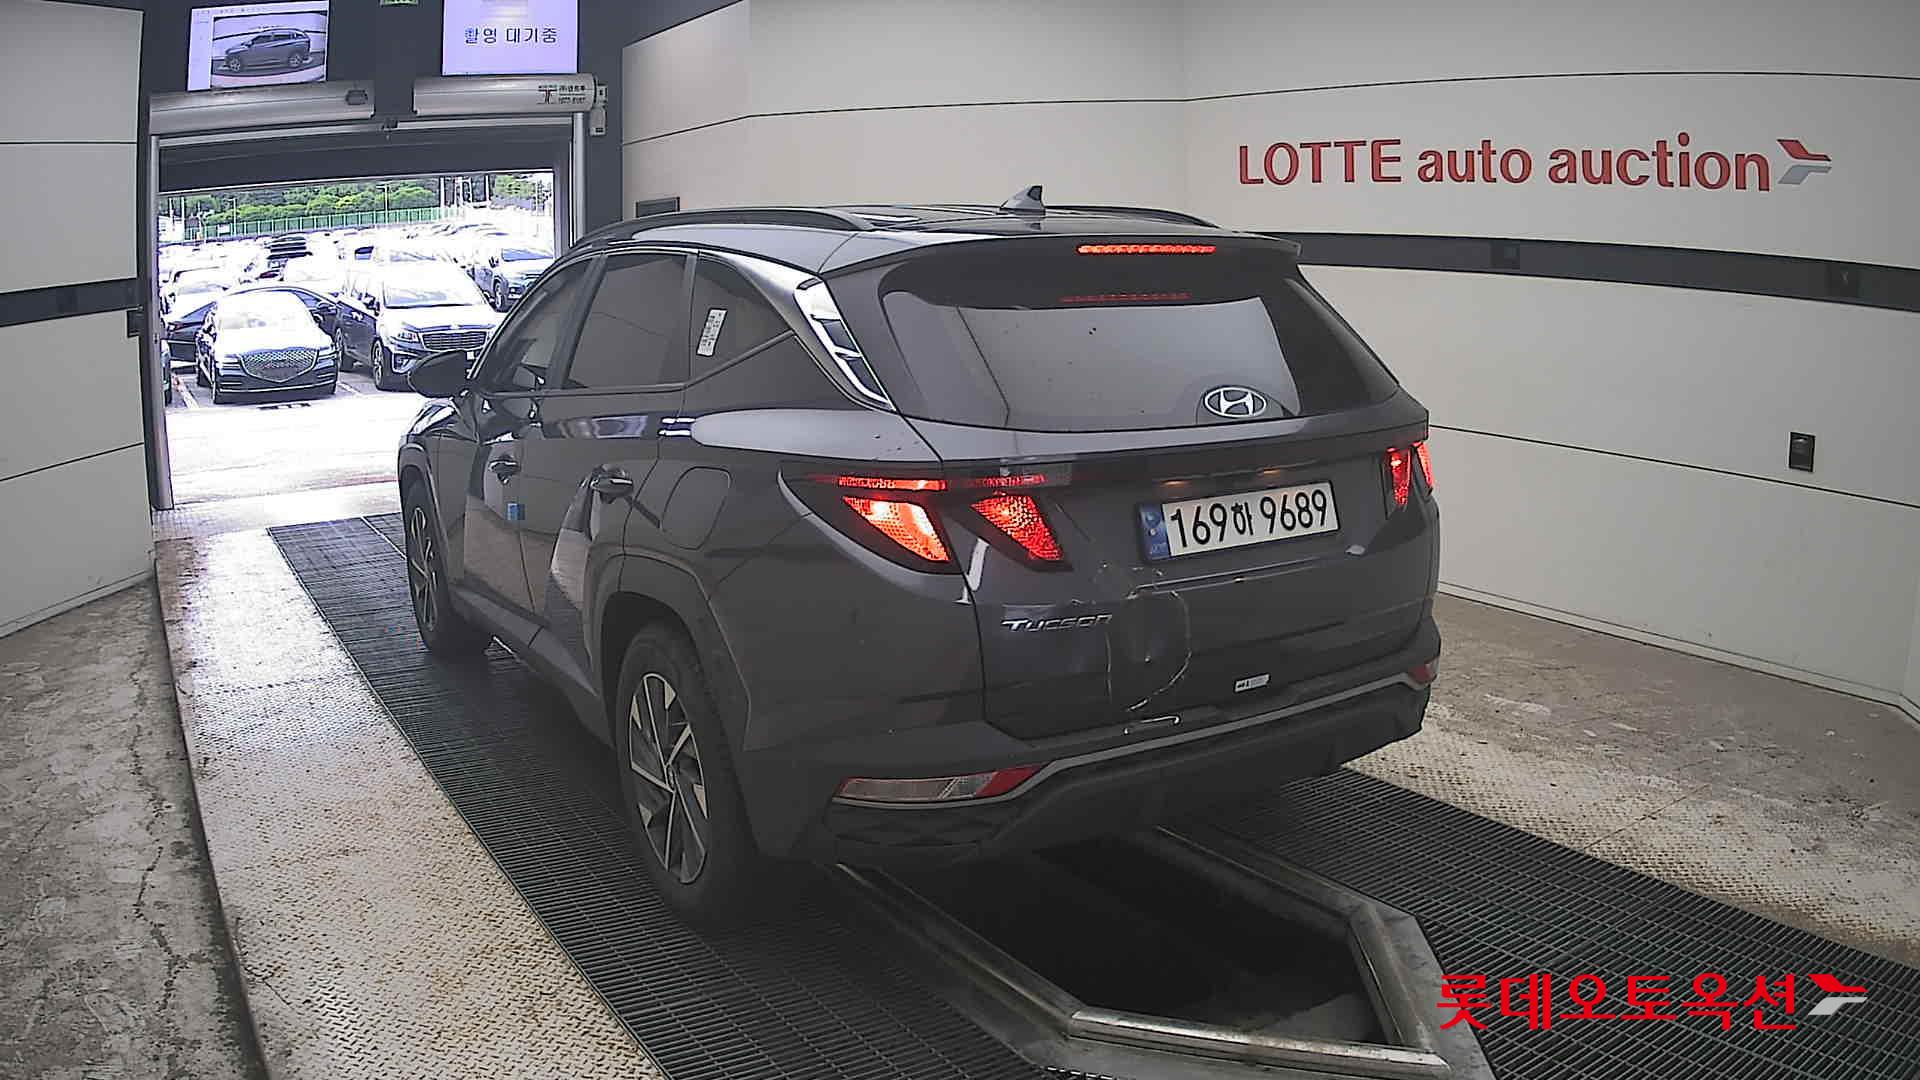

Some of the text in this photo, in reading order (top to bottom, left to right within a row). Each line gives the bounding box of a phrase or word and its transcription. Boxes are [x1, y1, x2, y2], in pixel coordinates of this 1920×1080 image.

[506, 27, 558, 44] 대기중
[1238, 132, 1771, 192] LOTTE auto auction
[1170, 488, 1328, 548] 169하 9689
